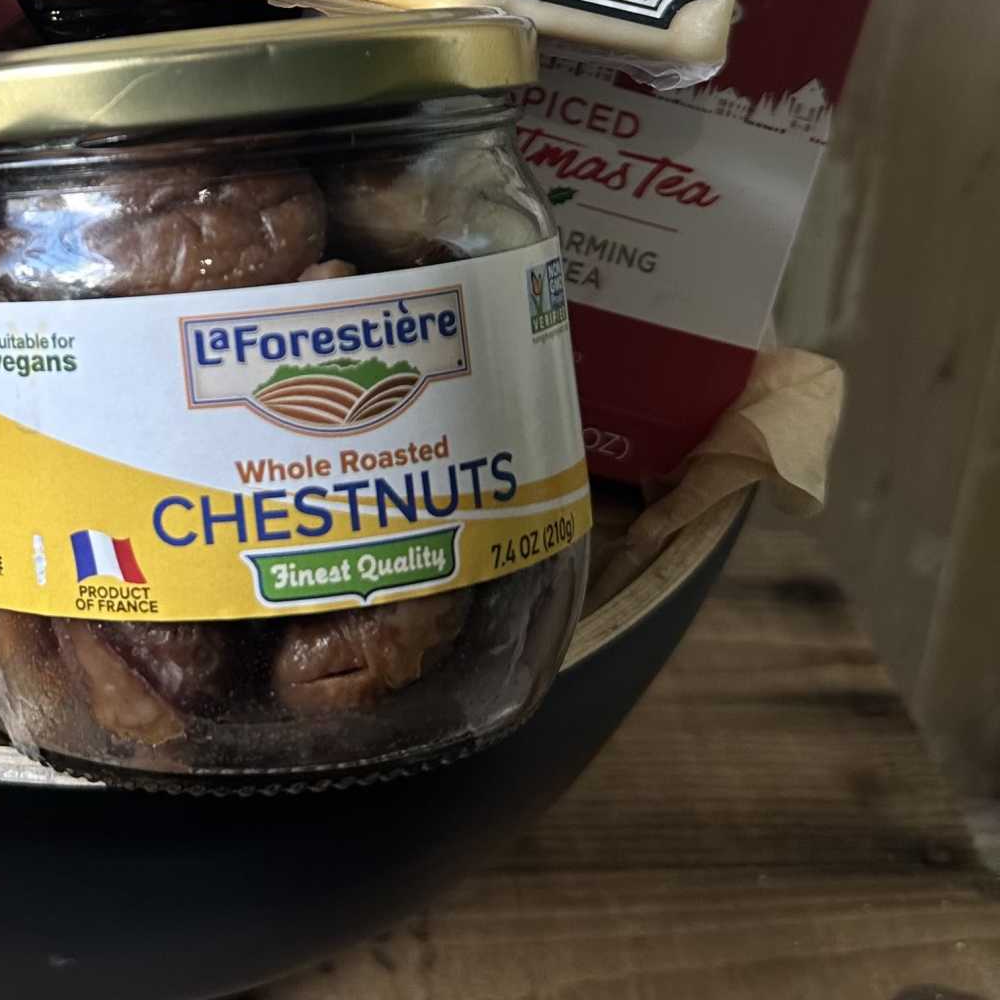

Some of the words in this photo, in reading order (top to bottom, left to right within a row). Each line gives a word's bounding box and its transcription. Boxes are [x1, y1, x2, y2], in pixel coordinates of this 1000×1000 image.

[523, 85, 641, 140] PICED
[618, 149, 725, 208] Tea
[567, 260, 602, 291] EA
[51, 332, 76, 349] for
[235, 452, 331, 484] Whole
[339, 435, 450, 473] Roasted
[152, 452, 517, 547] CHESTNUTS
[490, 541, 516, 570] 7.4
[519, 530, 540, 559] OZ
[541, 510, 576, 552] (210g)
[269, 554, 351, 590] Finest
[357, 545, 447, 581] Quality
[75, 598, 96, 611] OF
[97, 599, 159, 614] FRANCE
[79, 585, 151, 600] PRODUCT
